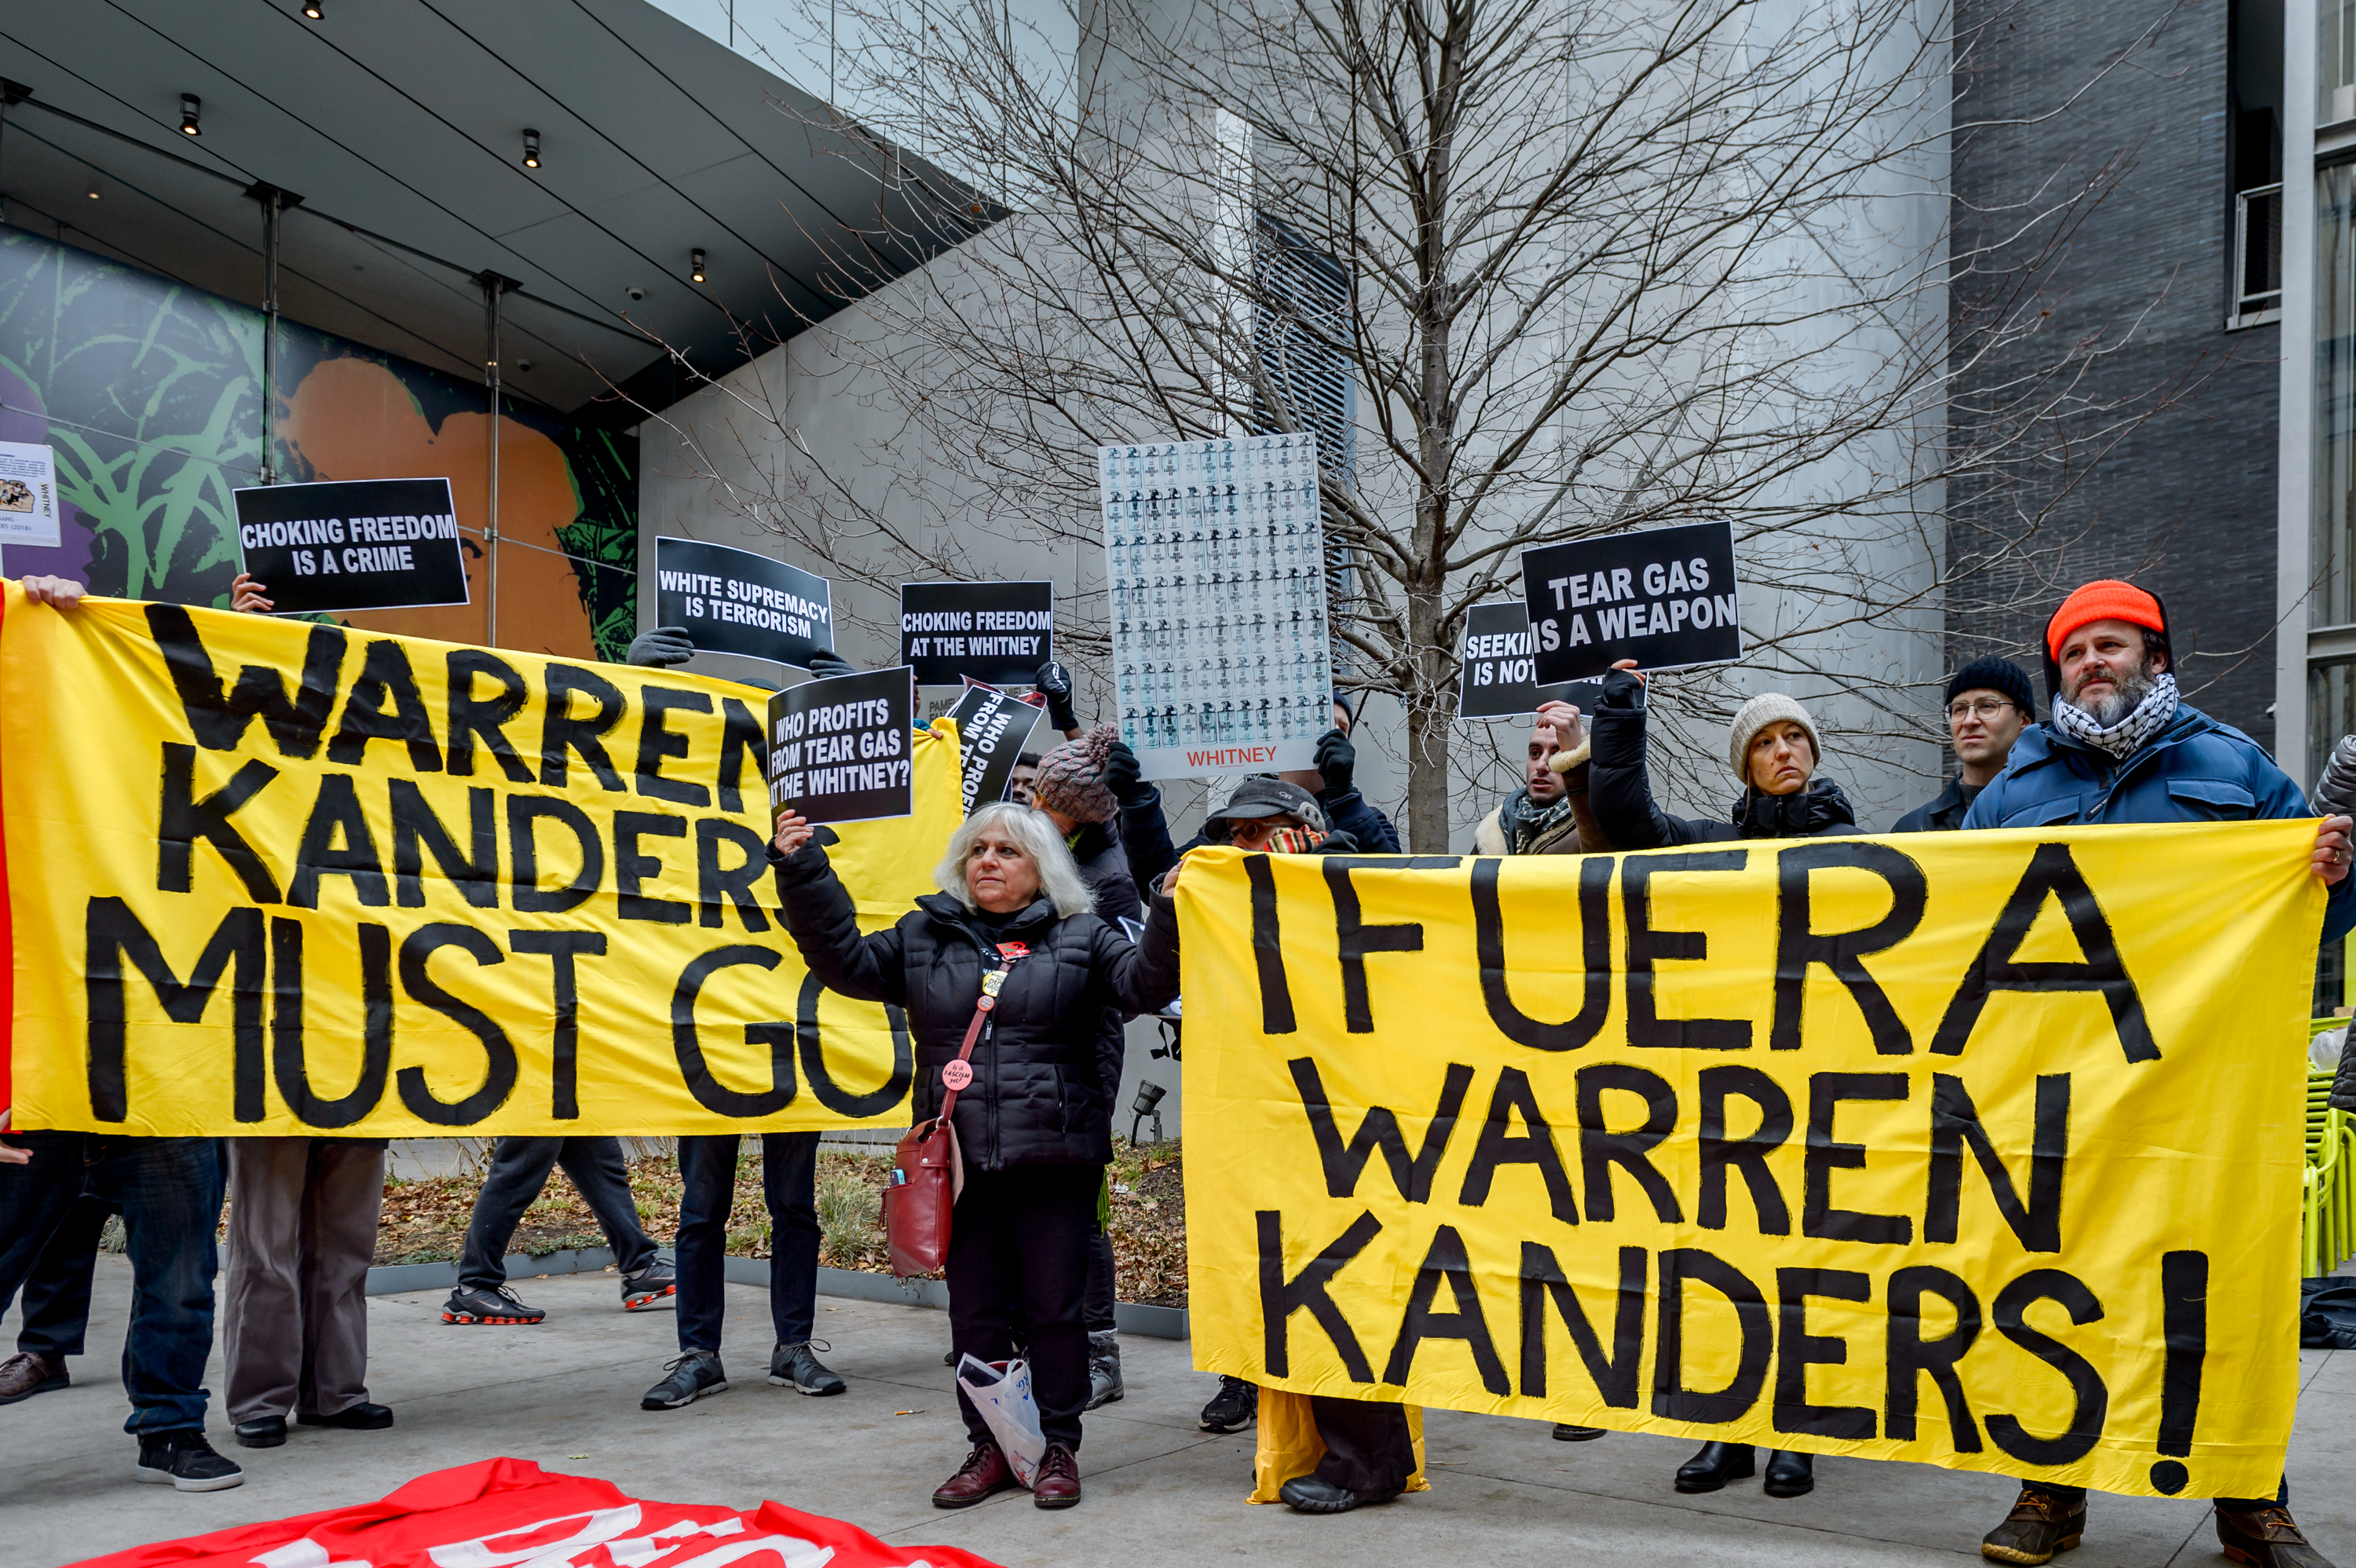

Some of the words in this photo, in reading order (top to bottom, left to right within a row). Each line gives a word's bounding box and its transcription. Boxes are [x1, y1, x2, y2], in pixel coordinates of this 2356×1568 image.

[41, 484, 52, 518] WHITNEY
[241, 518, 345, 549] CHOKING
[349, 514, 456, 543] FREEDOM
[291, 550, 316, 576] IS
[323, 549, 340, 574] A
[342, 546, 415, 573] CRIME
[659, 570, 723, 598] WHITE
[726, 579, 829, 624] SUPREMACY
[1548, 568, 1635, 610] TEAR
[1643, 557, 1710, 596] GAS
[685, 596, 704, 618] IS
[708, 598, 811, 639] TERRORISM
[902, 611, 972, 633] CHOKING
[976, 610, 1051, 630] FREEDOM
[1531, 619, 1560, 654] IS
[1569, 614, 1592, 648] A
[1597, 593, 1738, 641] WEAPON
[909, 638, 930, 656] AT
[933, 637, 965, 656] THE
[968, 636, 1041, 656] WHITNEY
[1466, 632, 1532, 660] SEEKI
[1473, 663, 1493, 686] IS
[776, 711, 805, 744] WHO
[808, 698, 889, 735] PROFITS
[929, 696, 960, 713] PAME
[962, 693, 1005, 740] FROM
[771, 742, 801, 778] FROM
[804, 734, 855, 766] TEAR
[860, 728, 901, 759] GAS
[978, 712, 1013, 754] WHO
[1187, 746, 1277, 767] WHITNEY
[770, 780, 778, 810] AT
[779, 771, 804, 803] THE
[807, 759, 910, 796] WHITNEY?
[159, 741, 840, 933] KANDER
[86, 896, 607, 1128] MUST
[671, 944, 914, 1117] GO
[1289, 1057, 2072, 1253] WARREN
[1257, 1209, 2208, 1497] KANDERS!
